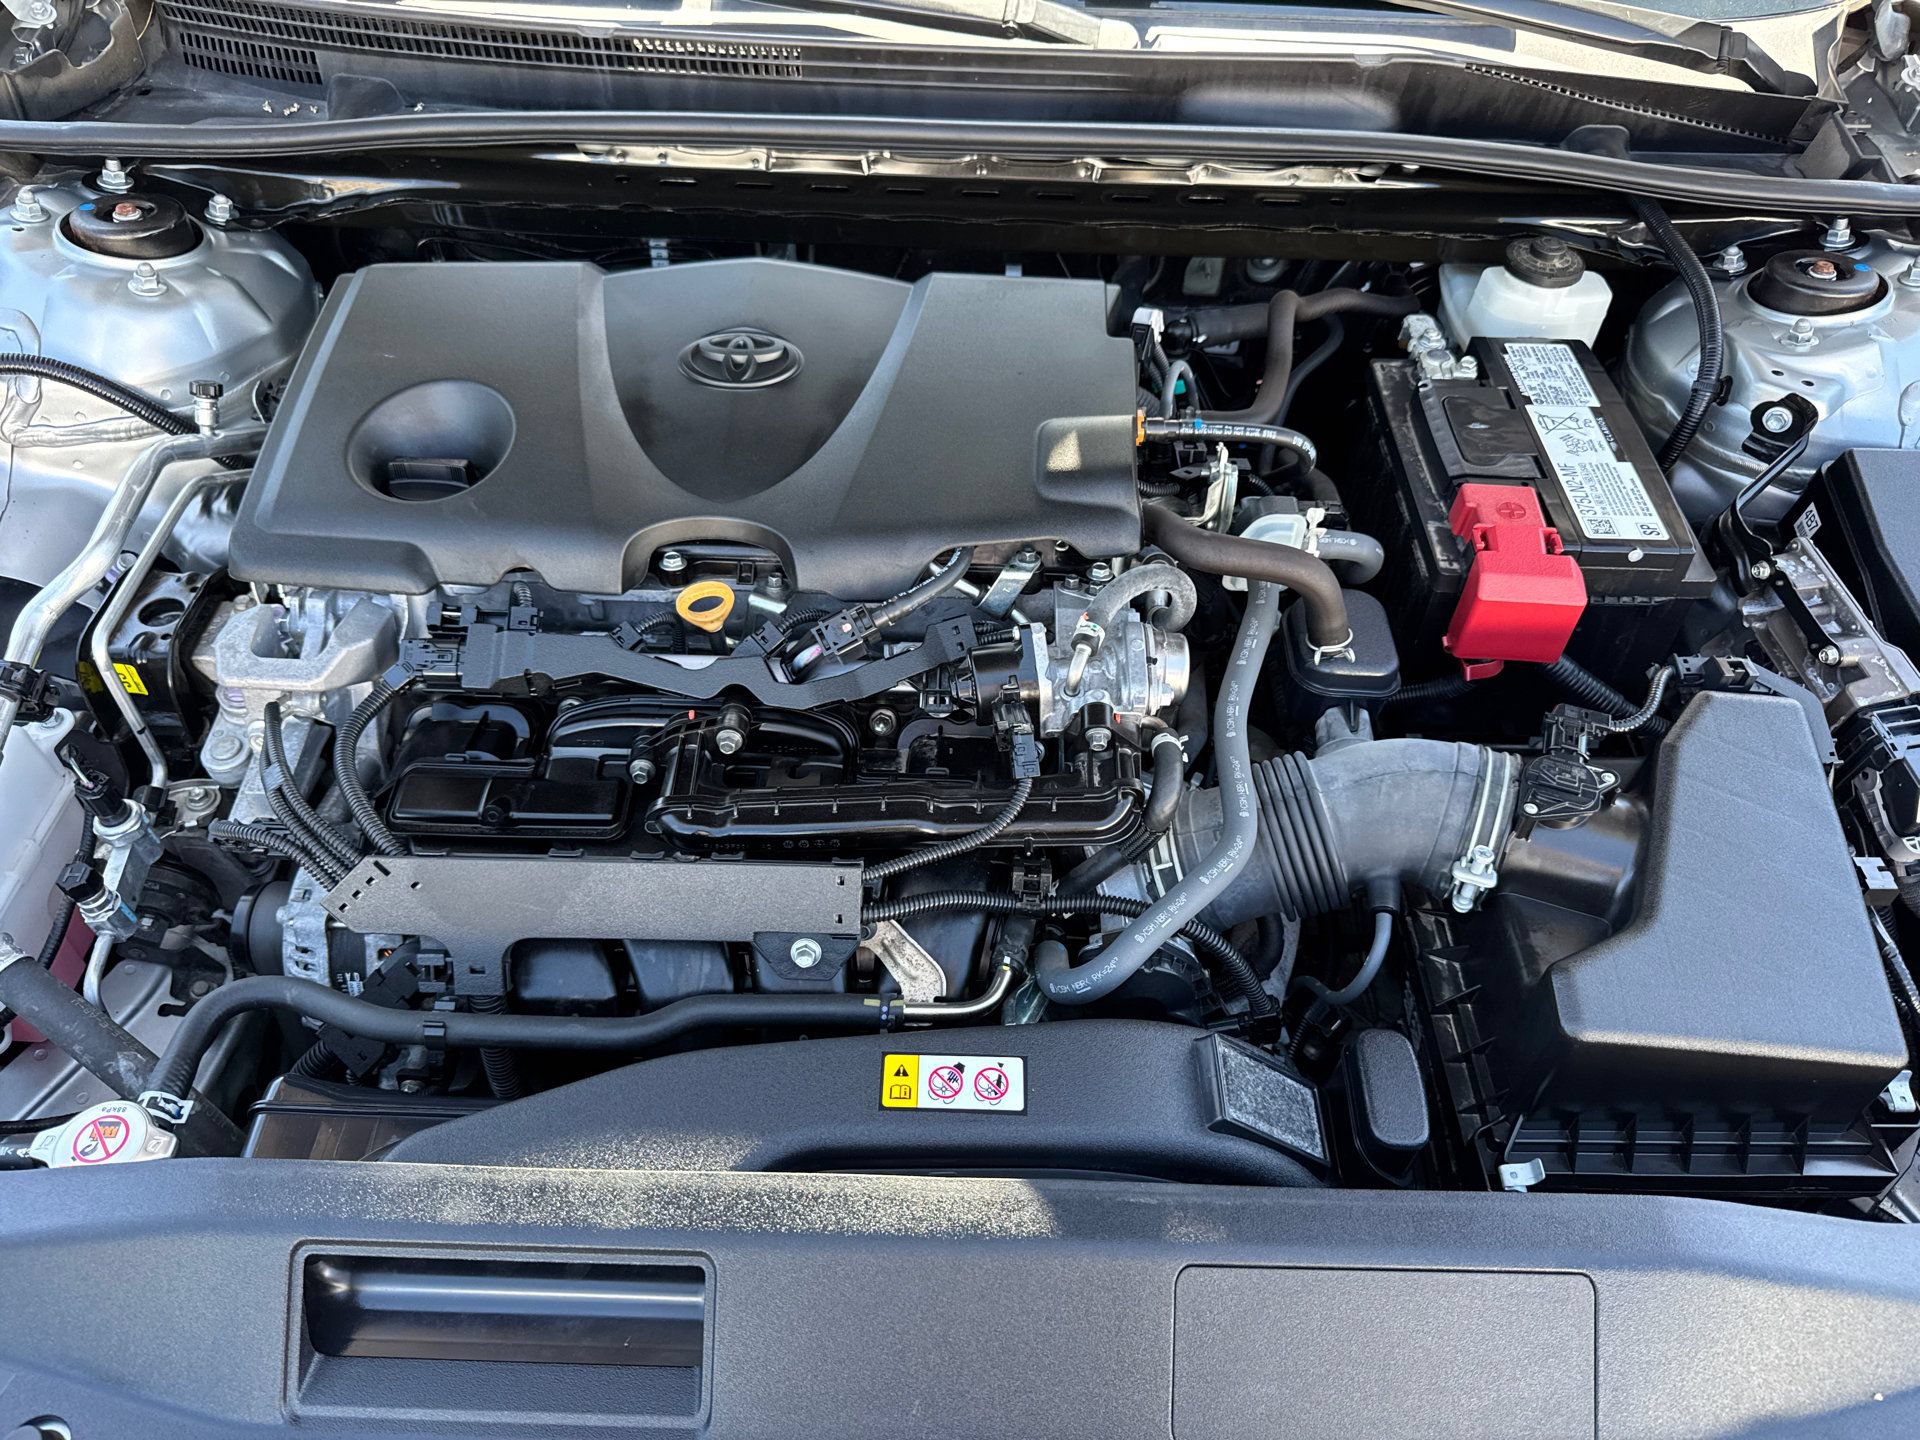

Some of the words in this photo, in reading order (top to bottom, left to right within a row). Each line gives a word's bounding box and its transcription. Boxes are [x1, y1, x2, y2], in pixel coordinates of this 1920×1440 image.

[1557, 463, 1598, 516] 375LN2-MF
[1639, 524, 1661, 536] SP
[1805, 510, 1819, 531] 4B7
